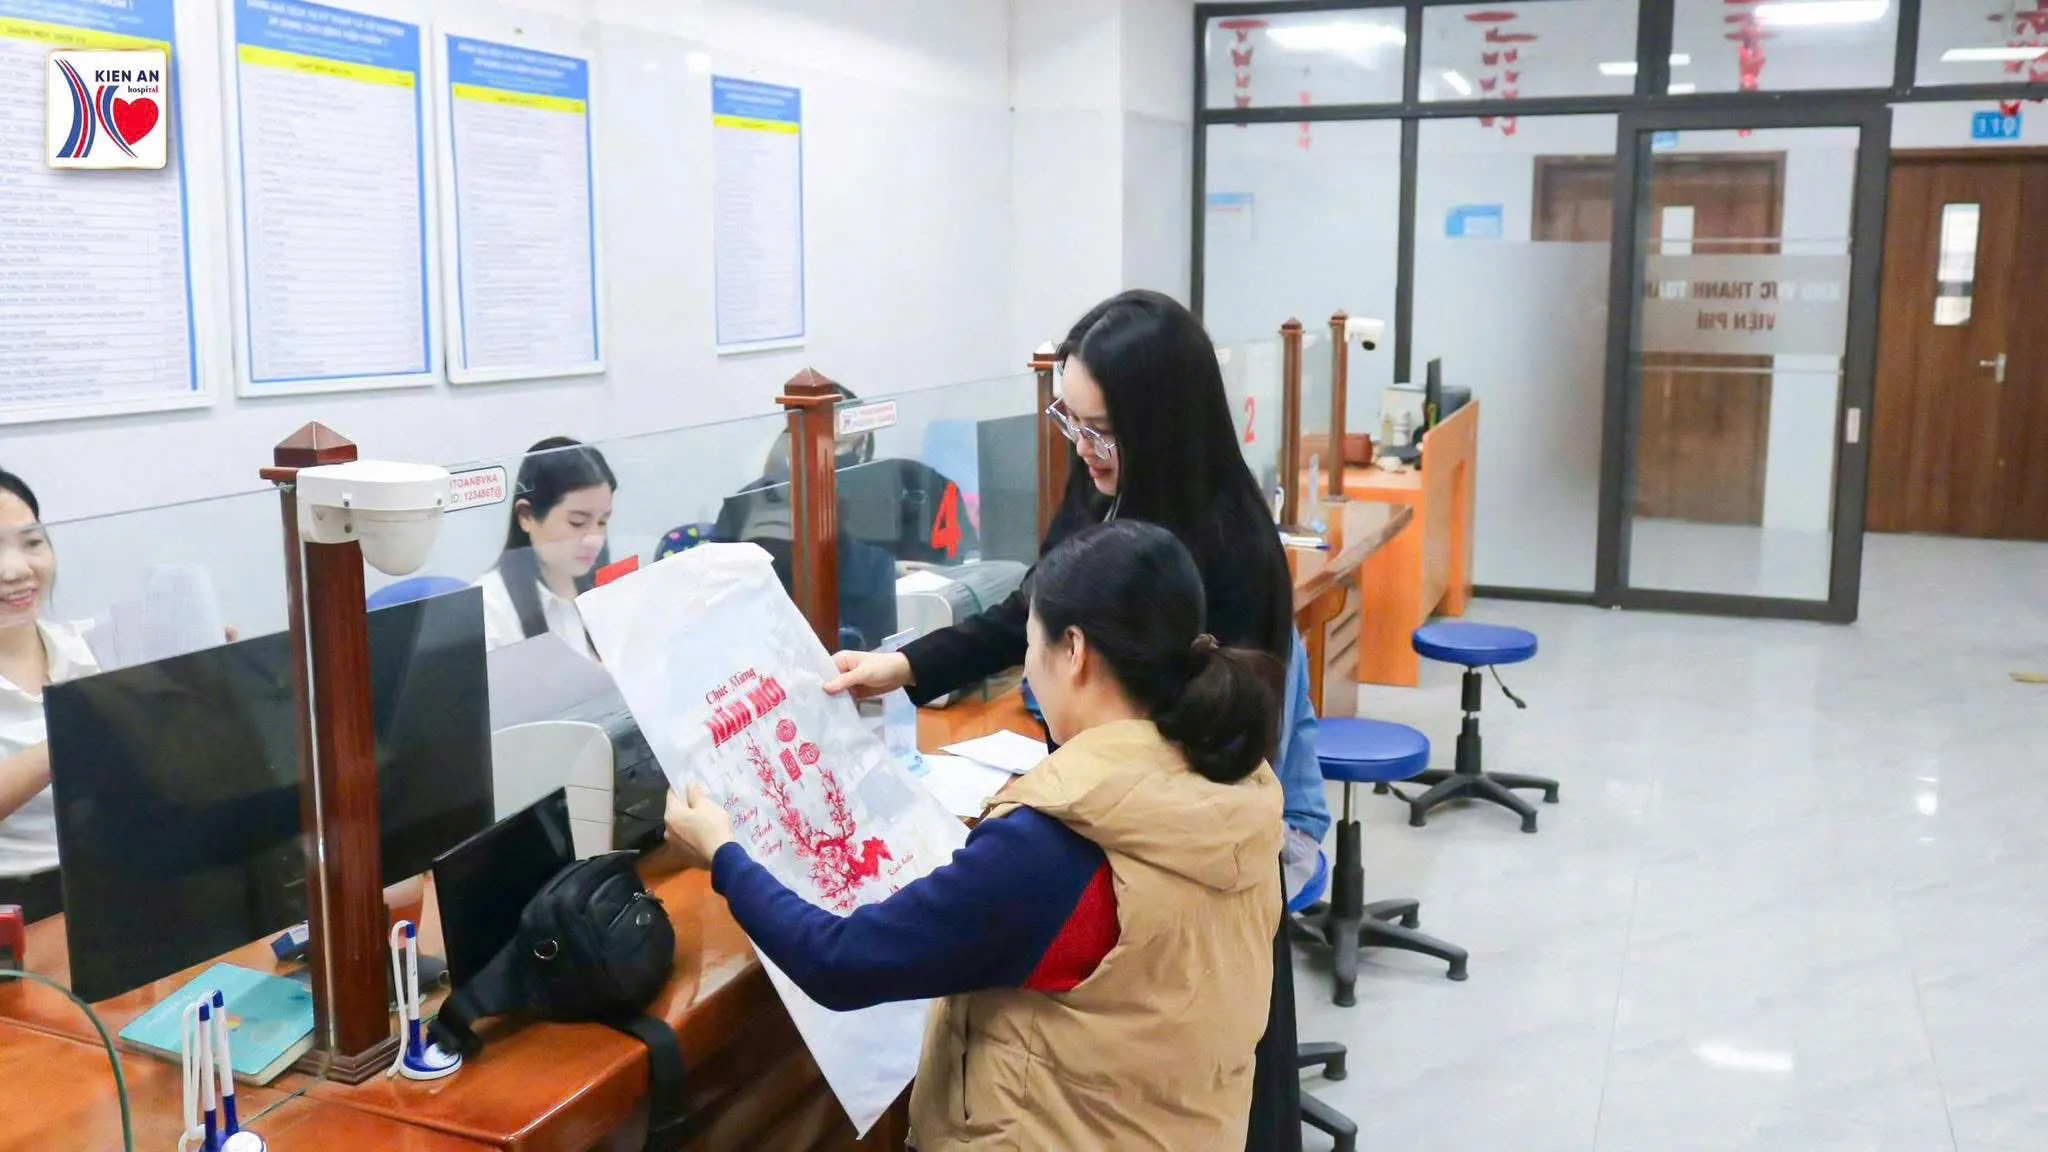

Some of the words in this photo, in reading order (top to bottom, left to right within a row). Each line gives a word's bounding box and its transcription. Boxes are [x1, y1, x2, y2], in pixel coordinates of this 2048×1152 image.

[1244, 396, 1256, 443] 2
[450, 474, 498, 490] TOANBVKA
[930, 481, 963, 558] 4
[704, 700, 752, 747] NĂM
[747, 673, 787, 719] MỚI
[705, 684, 728, 705] Chúc
